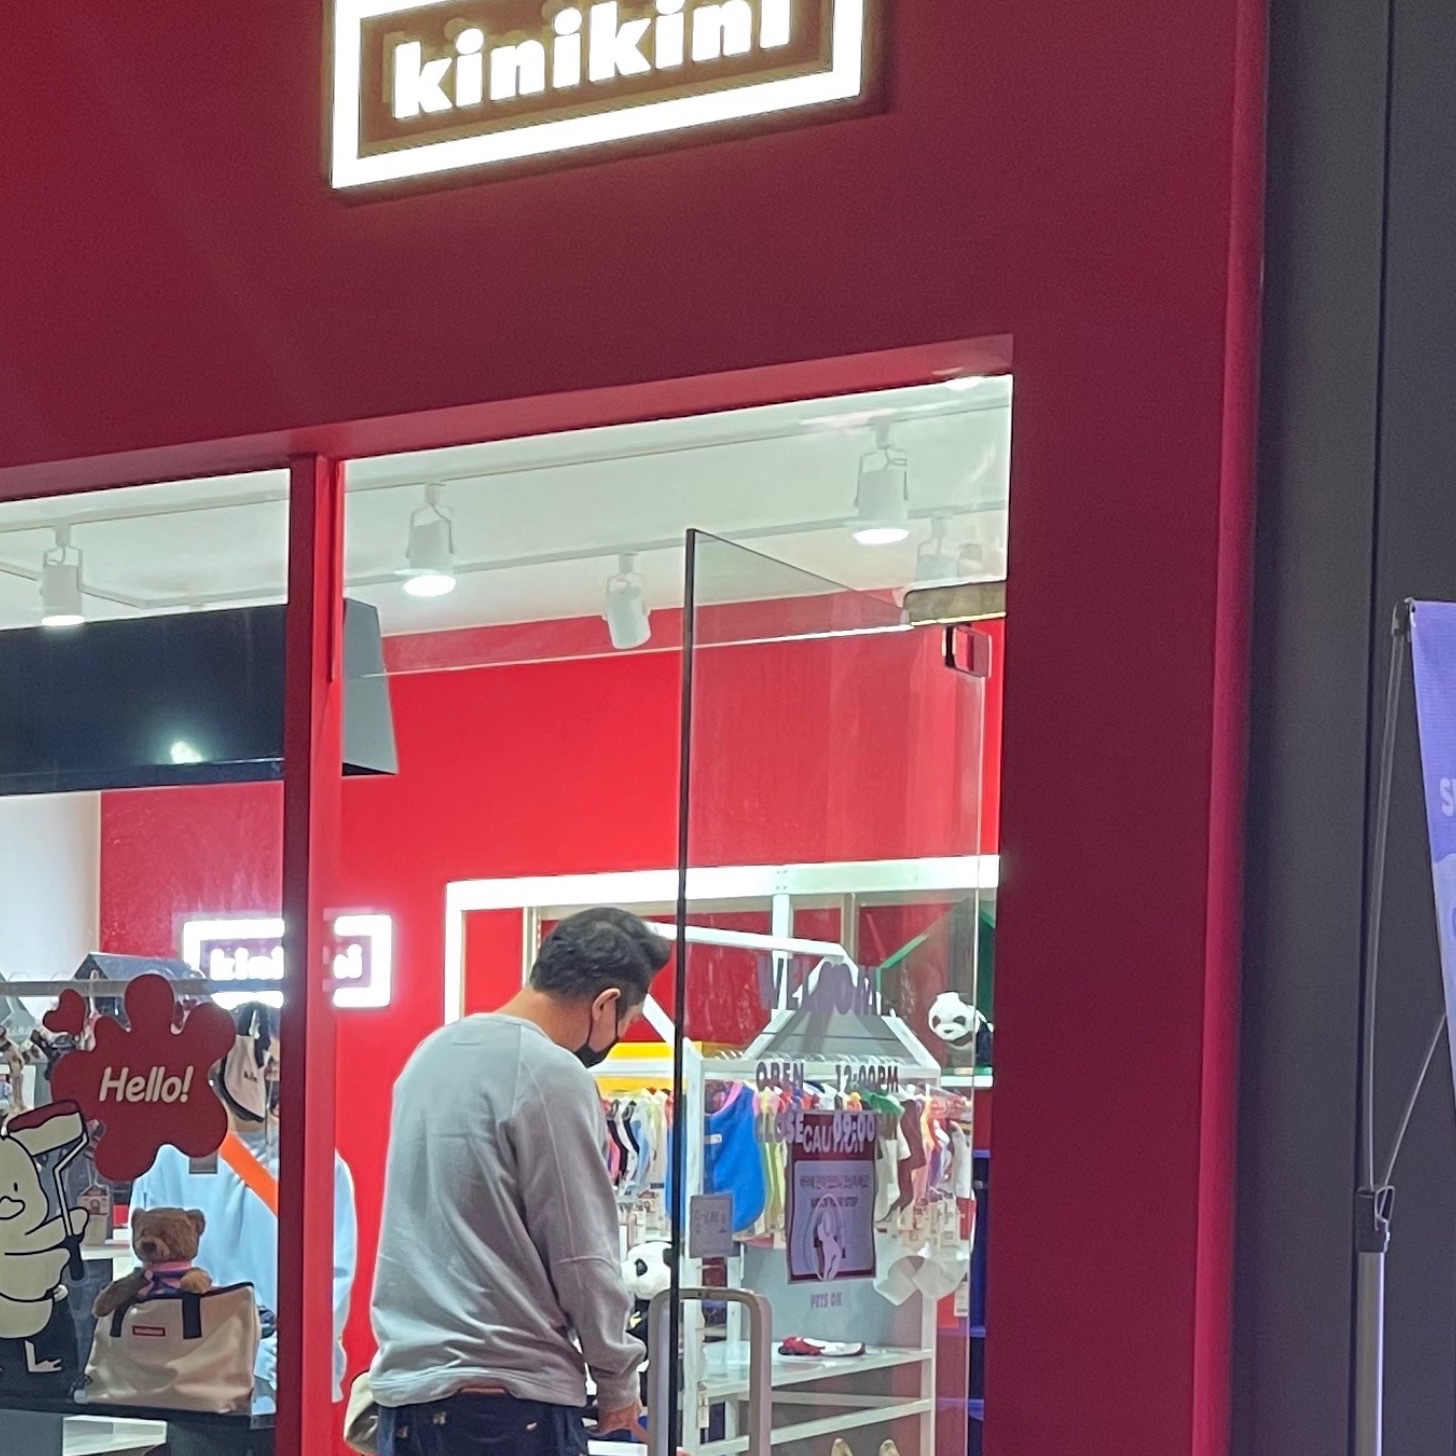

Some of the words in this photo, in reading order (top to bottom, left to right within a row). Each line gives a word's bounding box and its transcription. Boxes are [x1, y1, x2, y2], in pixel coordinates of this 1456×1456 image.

[394, 0, 791, 119] kinikini
[99, 1065, 194, 1103] Hello!
[756, 1061, 804, 1093] OPEN
